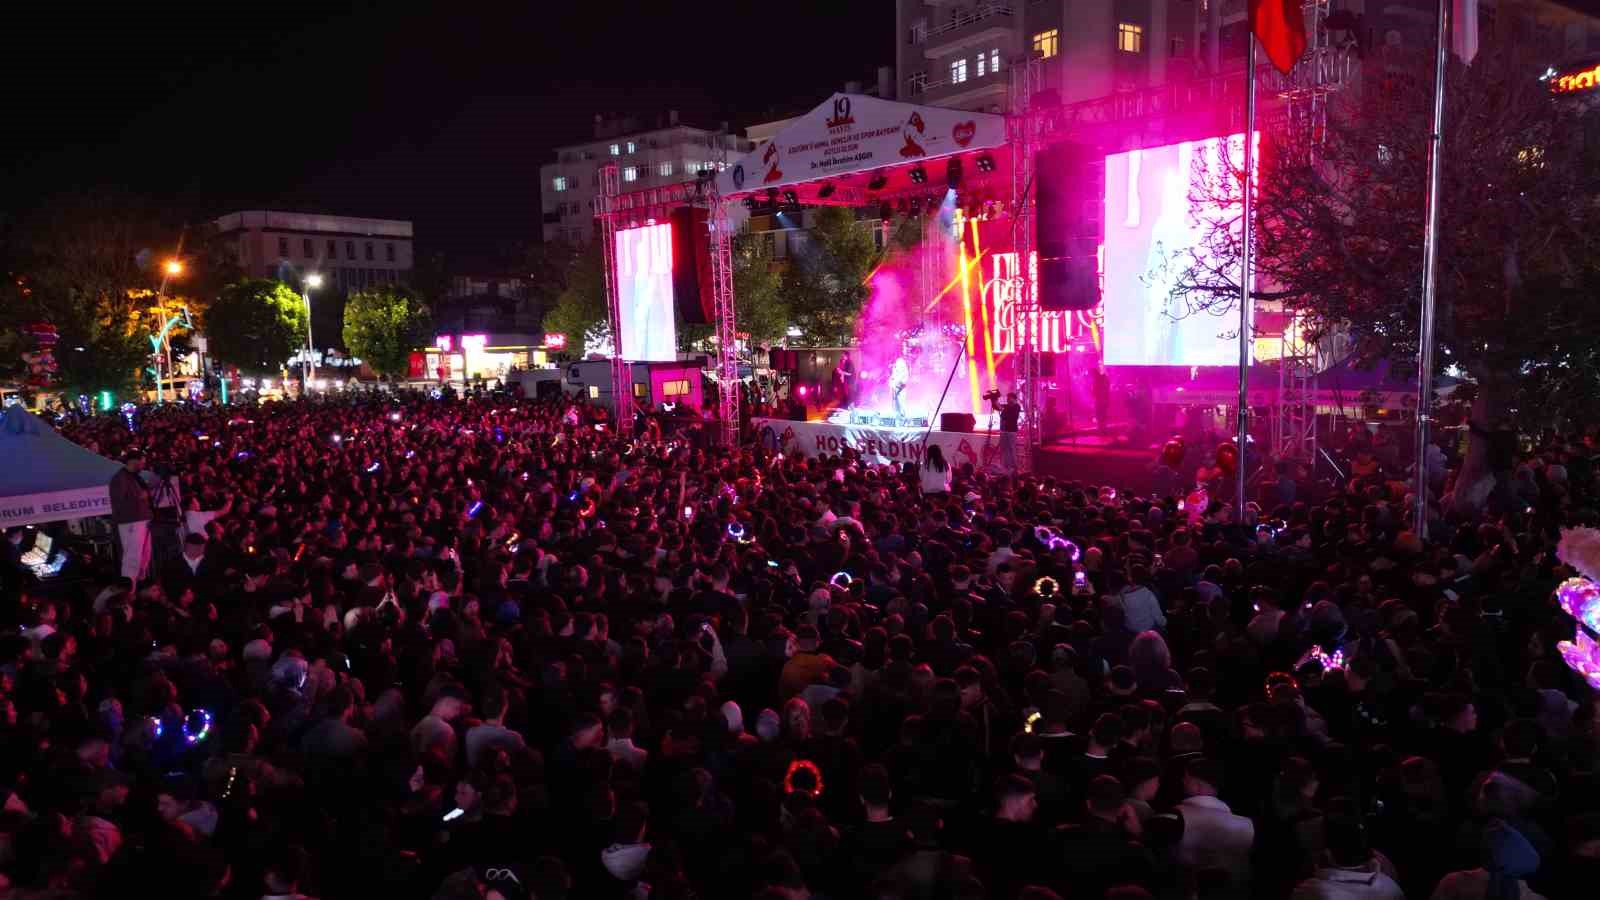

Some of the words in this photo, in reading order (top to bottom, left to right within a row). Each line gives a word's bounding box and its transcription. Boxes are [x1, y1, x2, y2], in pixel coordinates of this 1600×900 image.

[834, 96, 851, 121] 19
[0, 505, 35, 519] RUM
[42, 497, 111, 512] BELEDİYE
